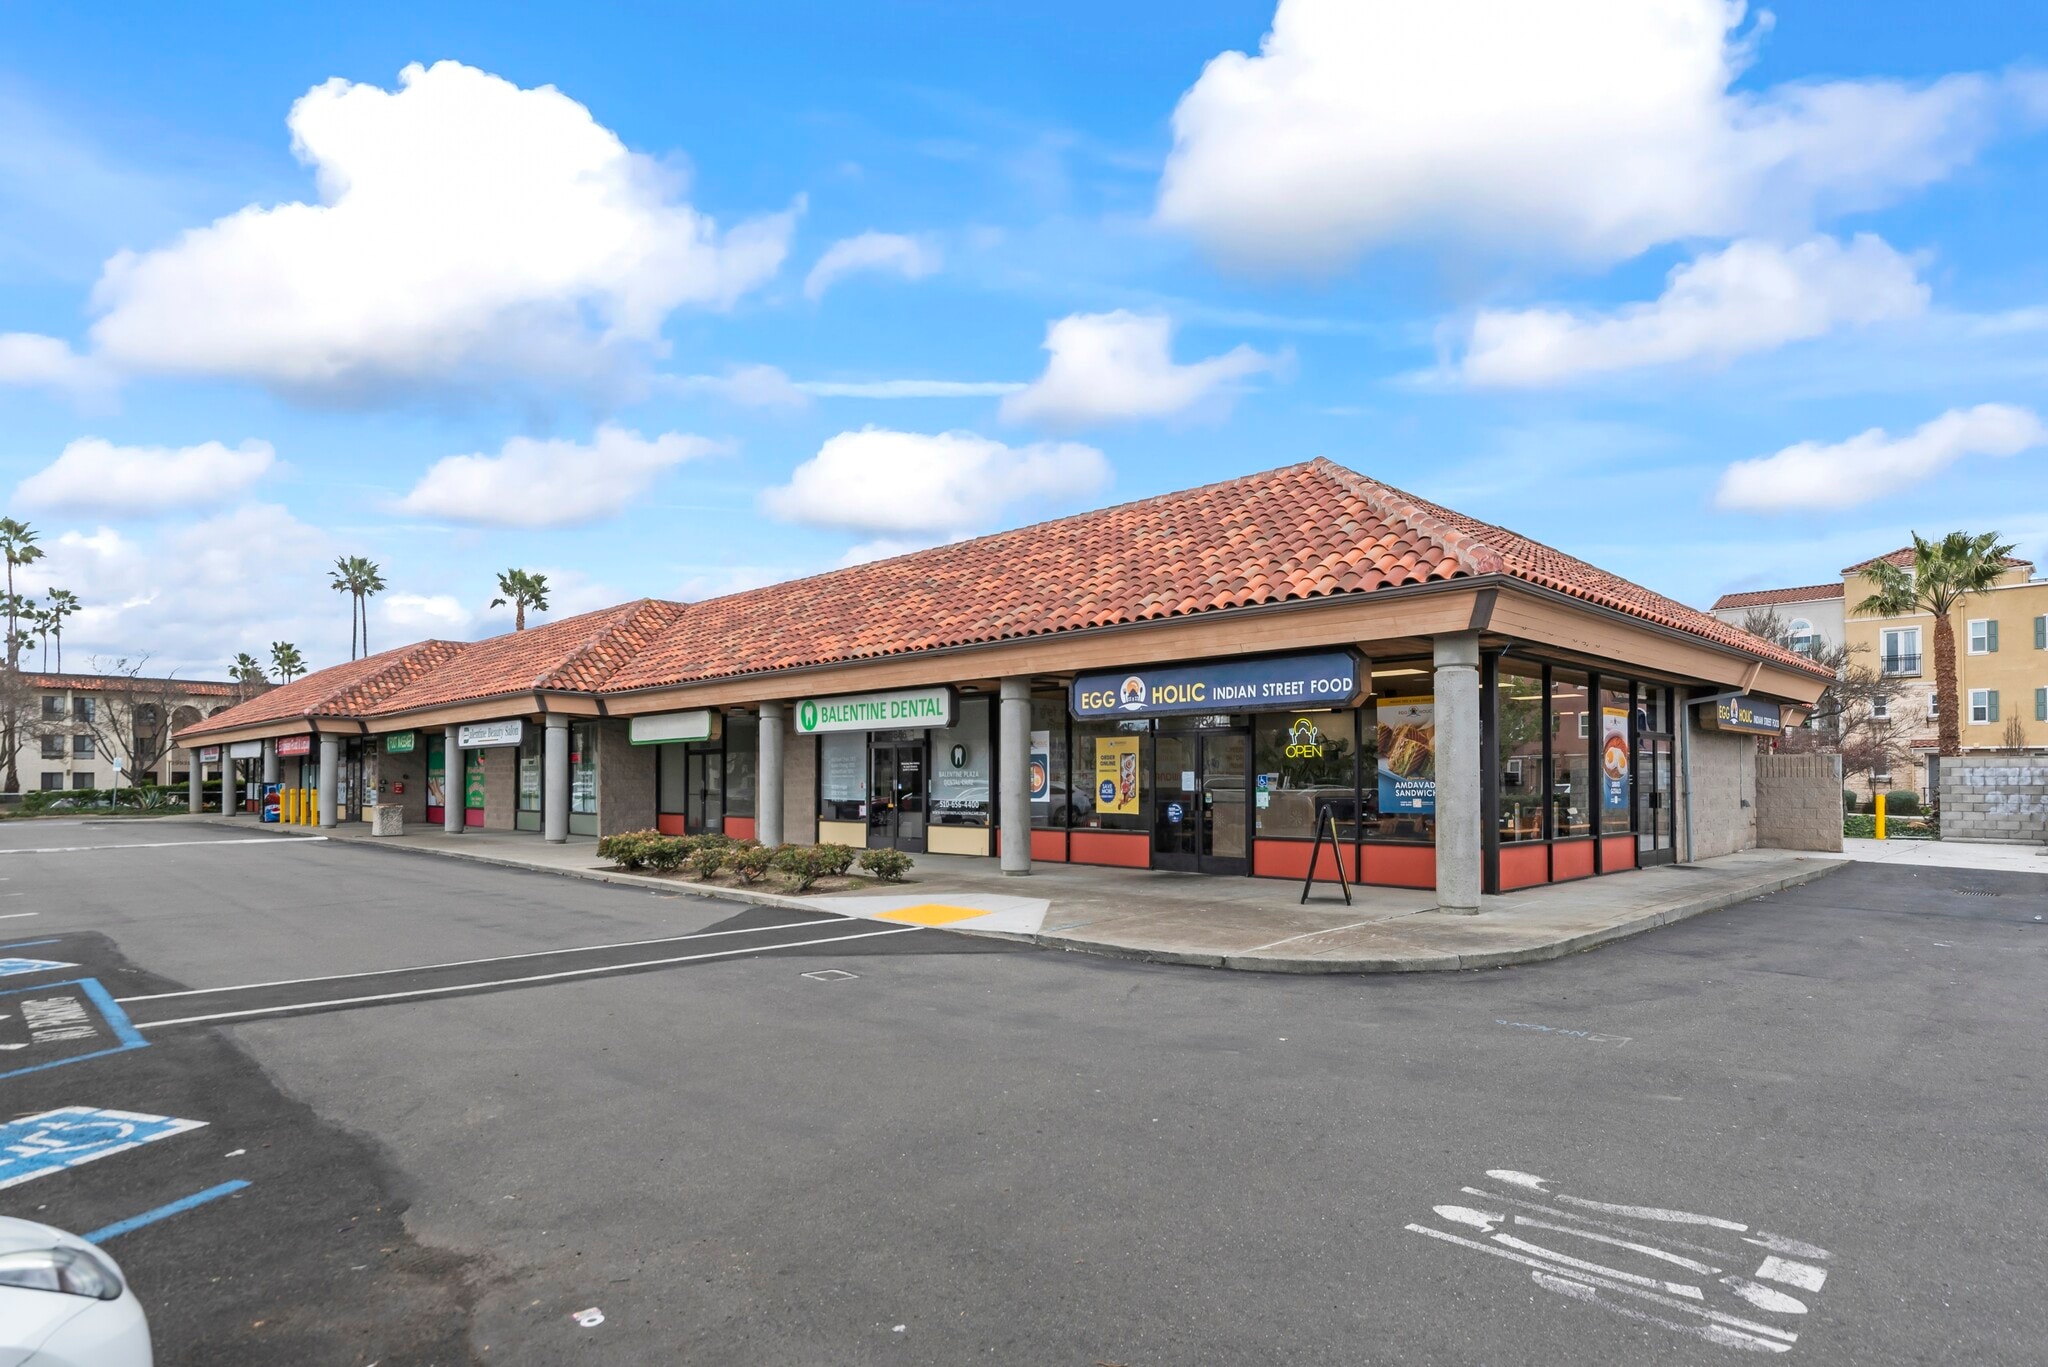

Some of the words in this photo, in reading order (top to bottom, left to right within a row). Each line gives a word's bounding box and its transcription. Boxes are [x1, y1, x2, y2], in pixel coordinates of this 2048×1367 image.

[1081, 690, 1116, 709] EGG
[1152, 682, 1206, 705] HOLIC
[1213, 684, 1256, 700] INDIAN
[1262, 681, 1305, 697] STREET
[1310, 677, 1353, 694] FOOD
[821, 701, 887, 723] BALENTINE
[890, 697, 943, 719] DENTAL
[1719, 705, 1730, 720] EGG
[1738, 708, 1753, 724] HOLIC
[505, 725, 519, 736] Salon
[1285, 744, 1322, 758] OPEN
[938, 770, 962, 778] BALENTINE
[964, 770, 979, 778] PLAZA
